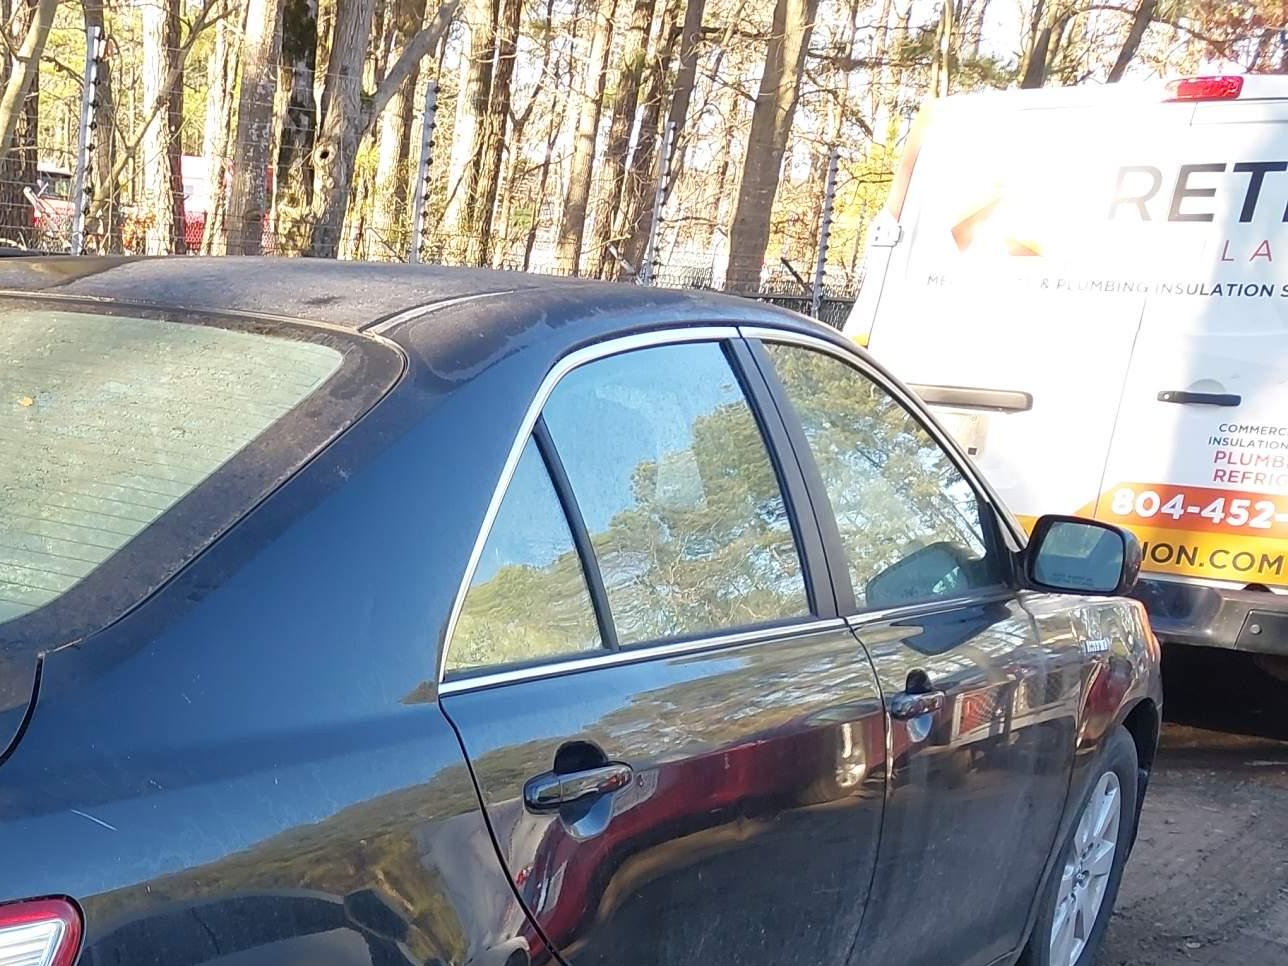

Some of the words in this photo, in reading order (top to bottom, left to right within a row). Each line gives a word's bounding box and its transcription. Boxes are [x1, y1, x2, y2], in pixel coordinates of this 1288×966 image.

[1107, 161, 1288, 224] RET
[1056, 278, 1149, 294] PLUMBING
[1154, 280, 1275, 298] INSULATION
[1218, 423, 1288, 436] COMMERC
[1213, 450, 1288, 468] PLUMB
